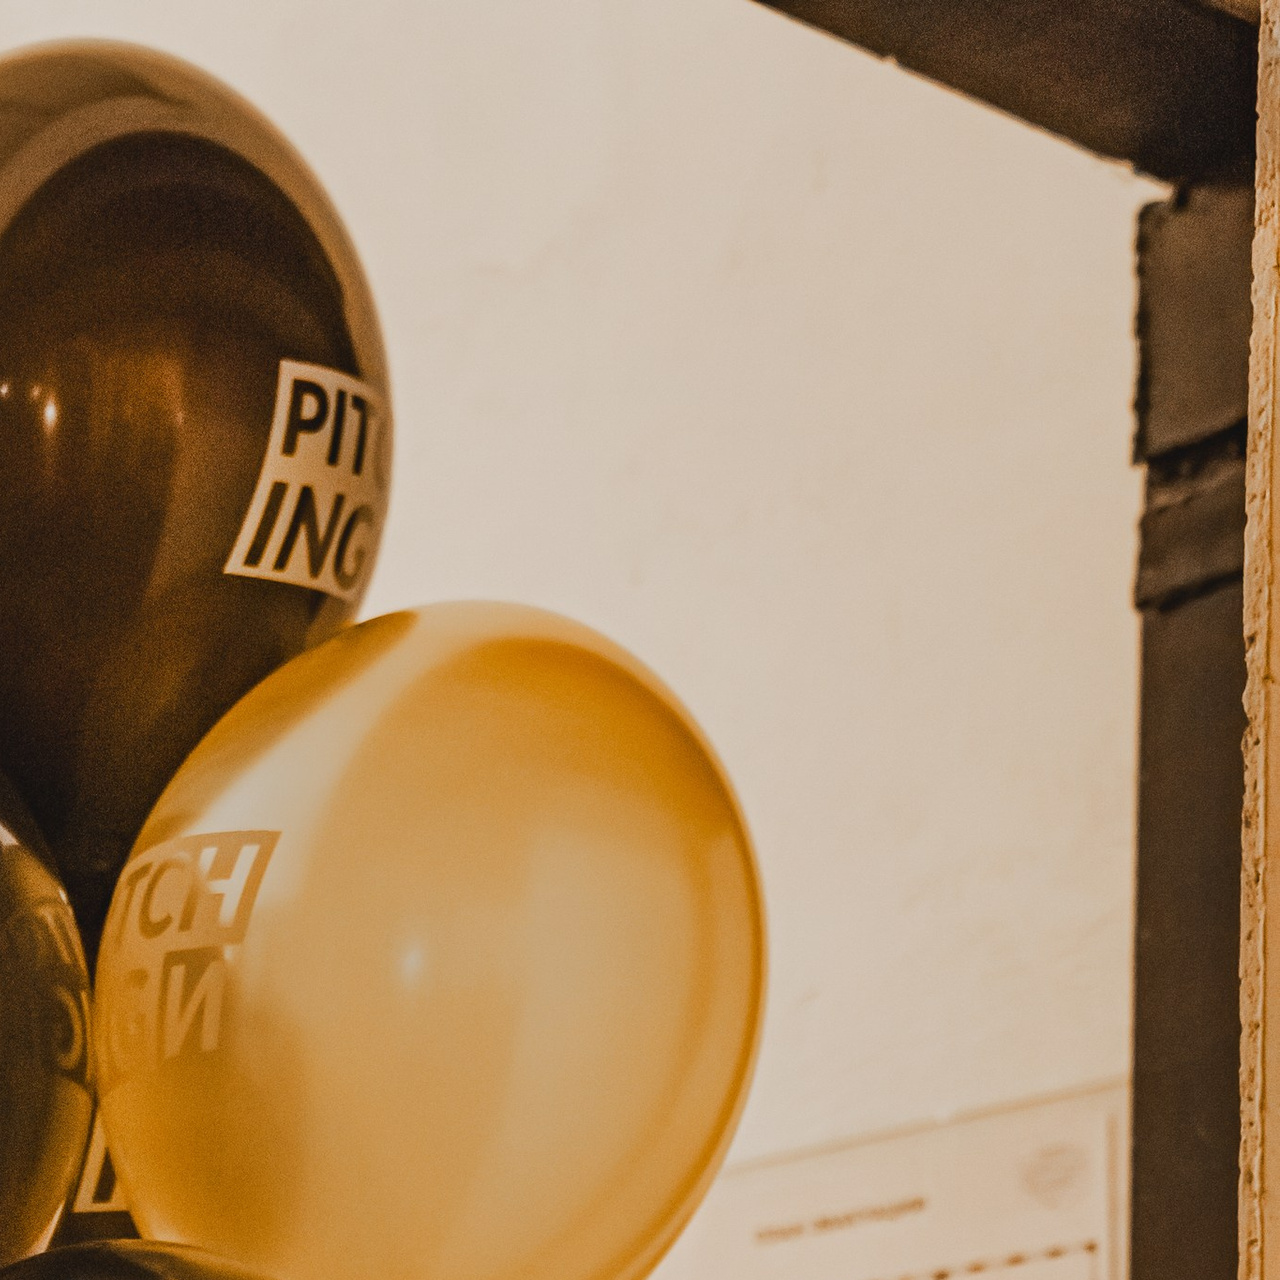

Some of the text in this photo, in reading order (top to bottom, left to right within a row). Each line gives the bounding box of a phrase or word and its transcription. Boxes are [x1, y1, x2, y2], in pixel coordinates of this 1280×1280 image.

[280, 378, 375, 476] PIT
[244, 481, 372, 590] ING
[116, 844, 262, 946] TCH
